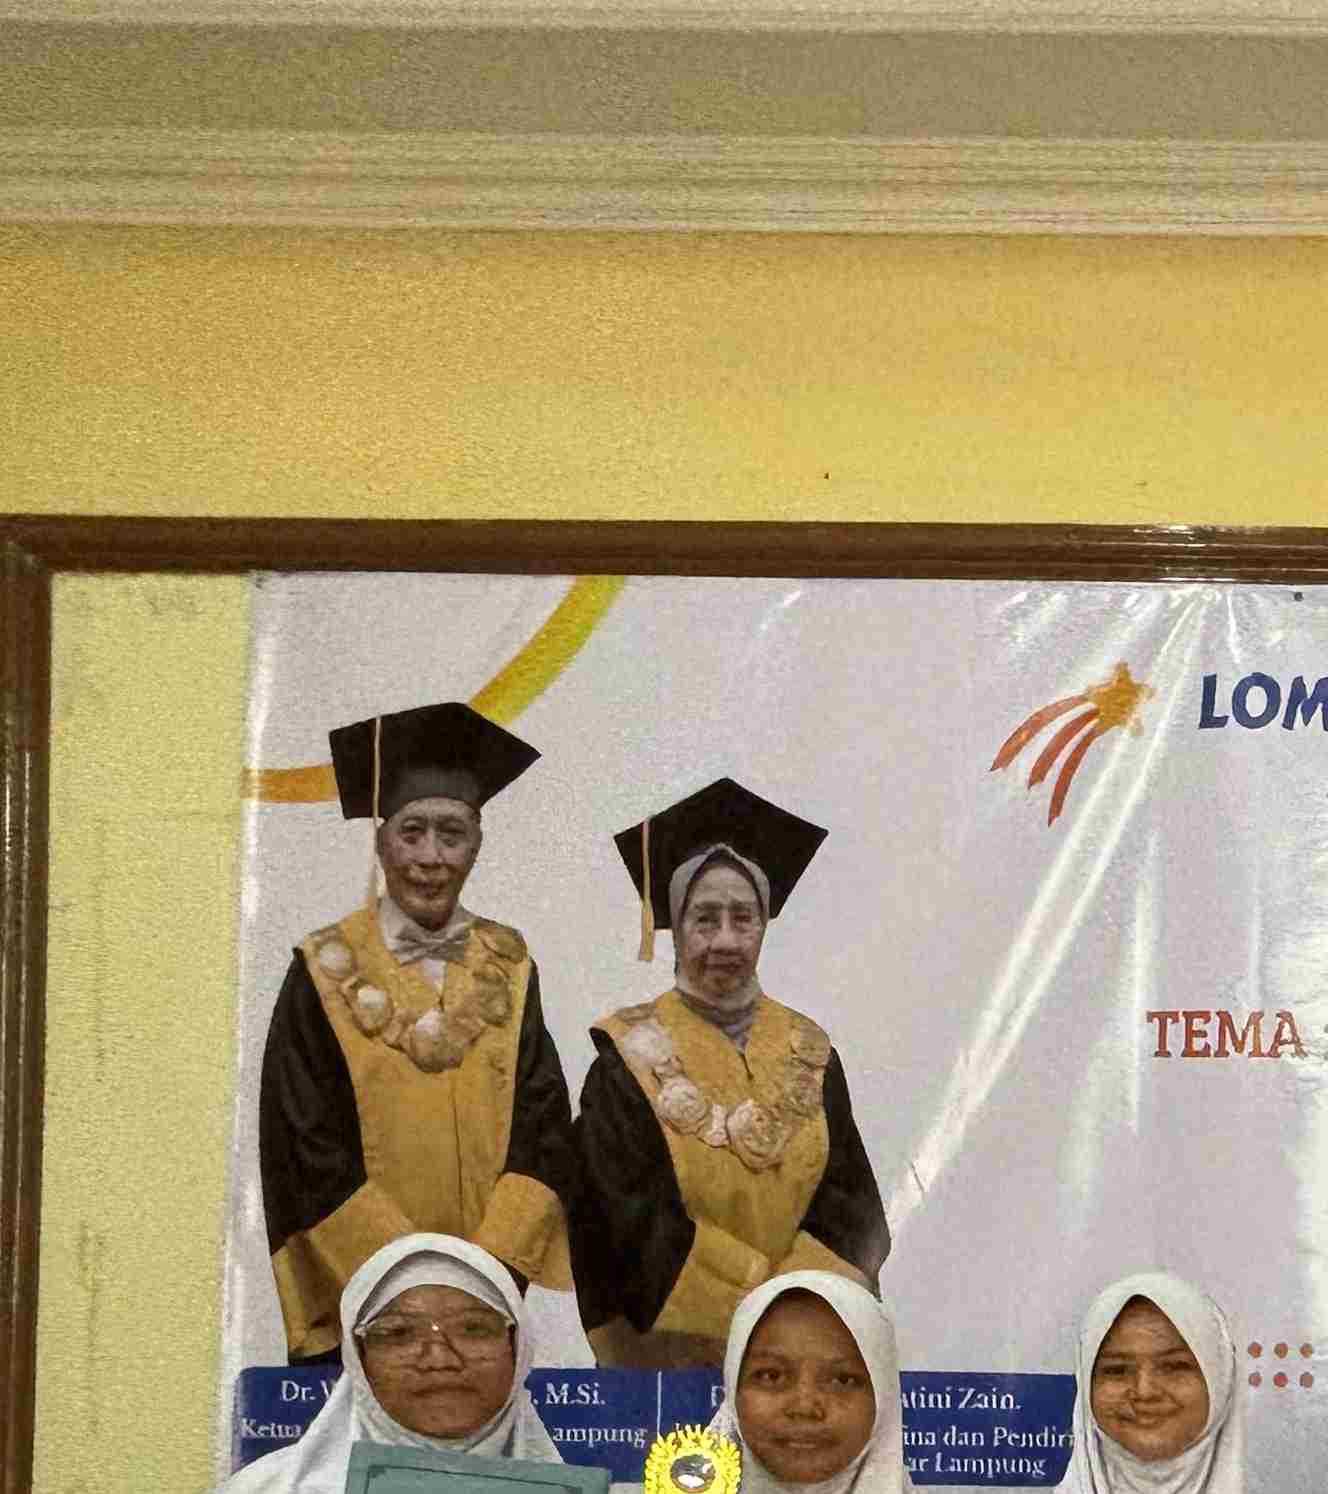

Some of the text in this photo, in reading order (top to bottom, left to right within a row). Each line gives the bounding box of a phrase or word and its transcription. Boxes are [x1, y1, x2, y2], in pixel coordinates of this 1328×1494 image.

[1146, 1010, 1305, 1061] TEMA
[281, 1380, 316, 1402] Dr.
[545, 1383, 606, 1405] M.Si.
[943, 1424, 984, 1447] dan
[935, 1452, 1046, 1477] Lampung
